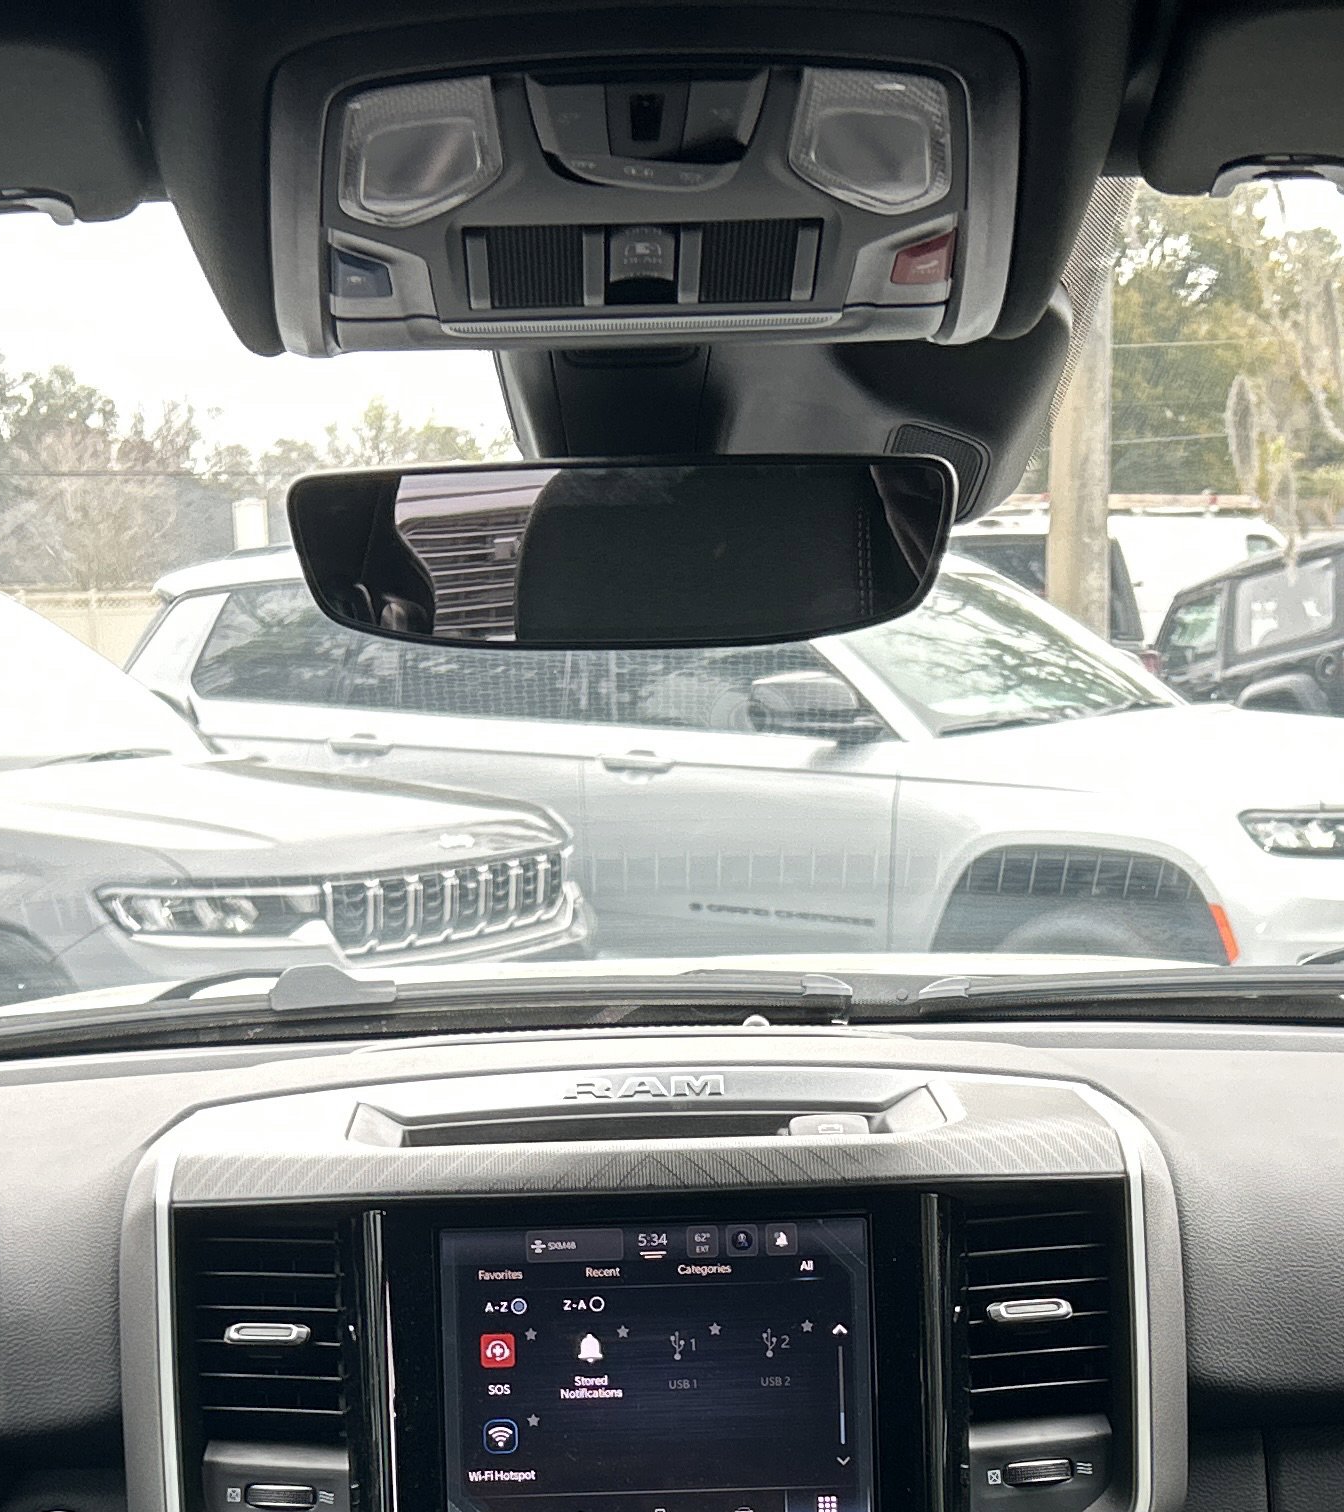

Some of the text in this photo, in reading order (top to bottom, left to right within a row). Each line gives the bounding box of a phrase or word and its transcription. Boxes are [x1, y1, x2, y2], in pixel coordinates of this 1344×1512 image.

[563, 1075, 724, 1099] RAM
[637, 1233, 668, 1247] 5:34
[478, 1260, 814, 1280] Favorites Recent Categories All
[484, 1300, 587, 1313] A-Z Z-A
[574, 1375, 608, 1386] Stored
[668, 1379, 689, 1389] USB
[760, 1376, 791, 1388] USB 2
[488, 1384, 511, 1395] SOS
[560, 1388, 623, 1399] Notifications
[494, 1470, 536, 1483] Hotspot
